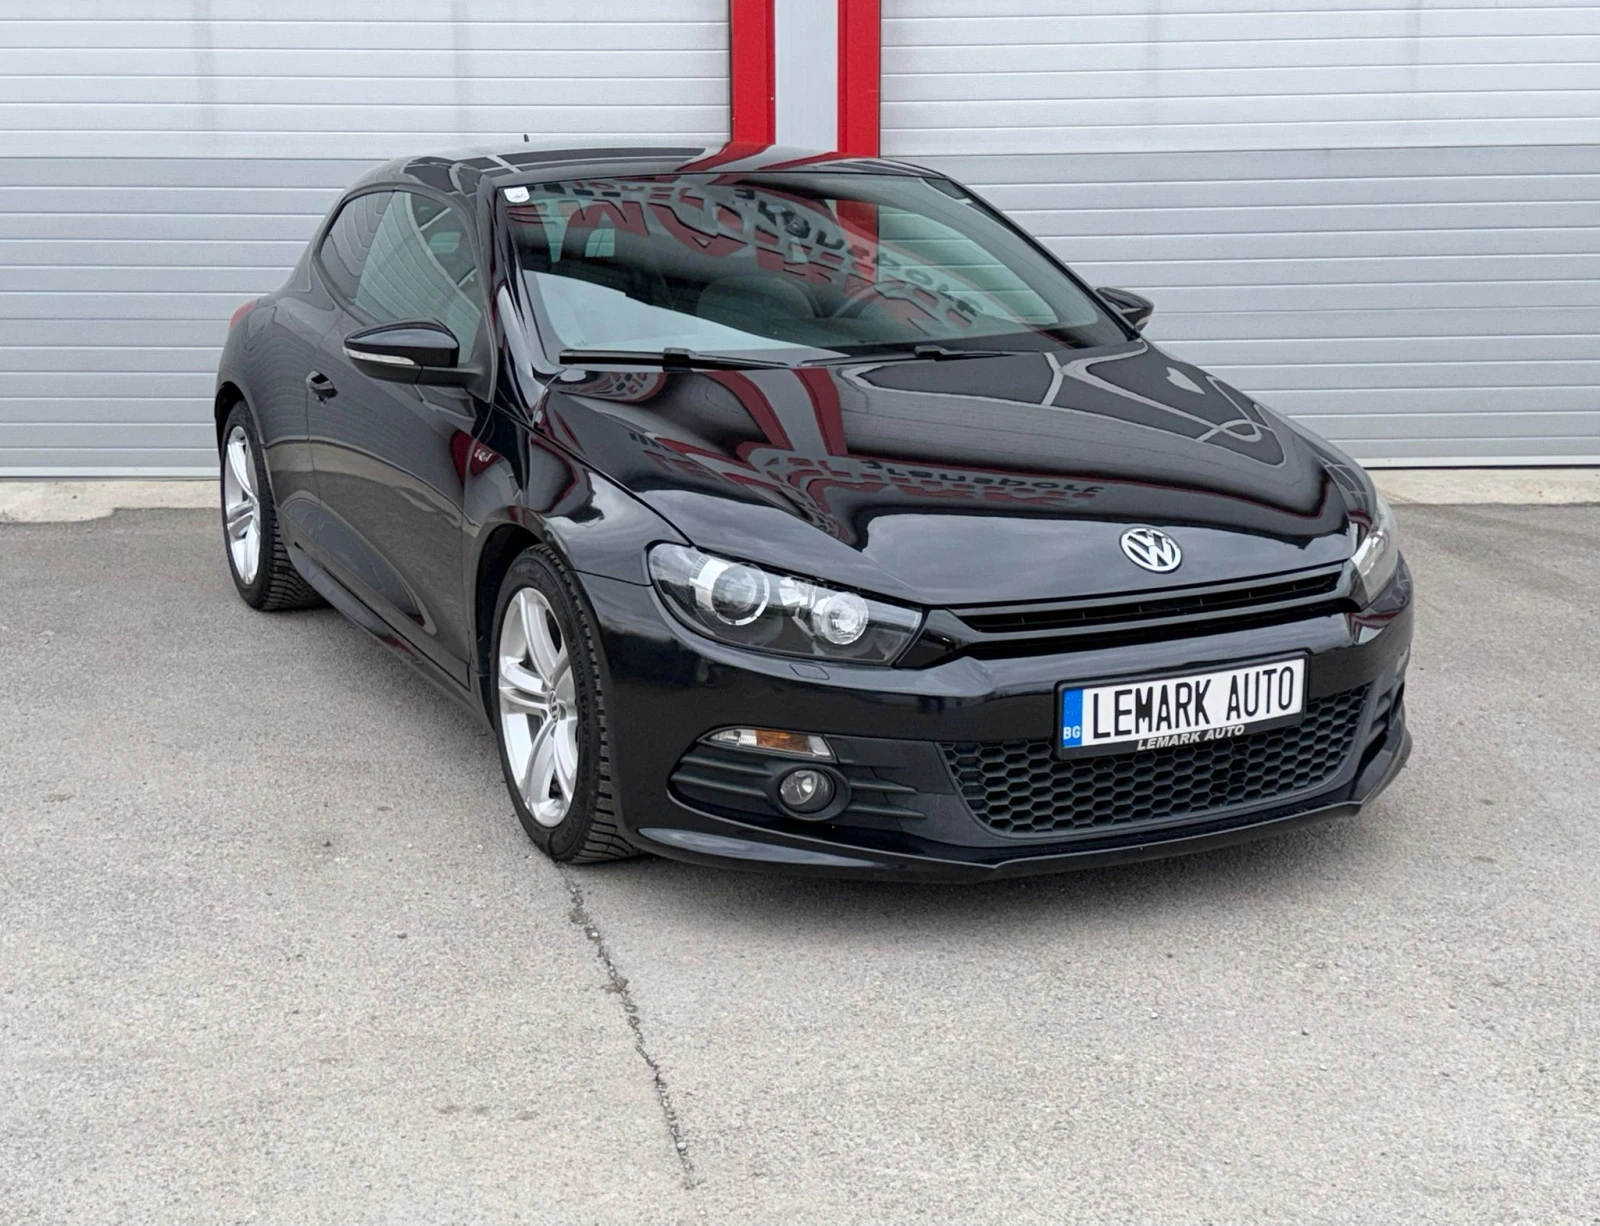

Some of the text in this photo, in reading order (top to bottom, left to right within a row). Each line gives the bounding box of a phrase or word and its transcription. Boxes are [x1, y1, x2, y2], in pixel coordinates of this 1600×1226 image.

[1092, 666, 1295, 739] LEMARK AUTO
[1063, 725, 1081, 740] BG
[1136, 724, 1245, 751] LEMARK AUTO
